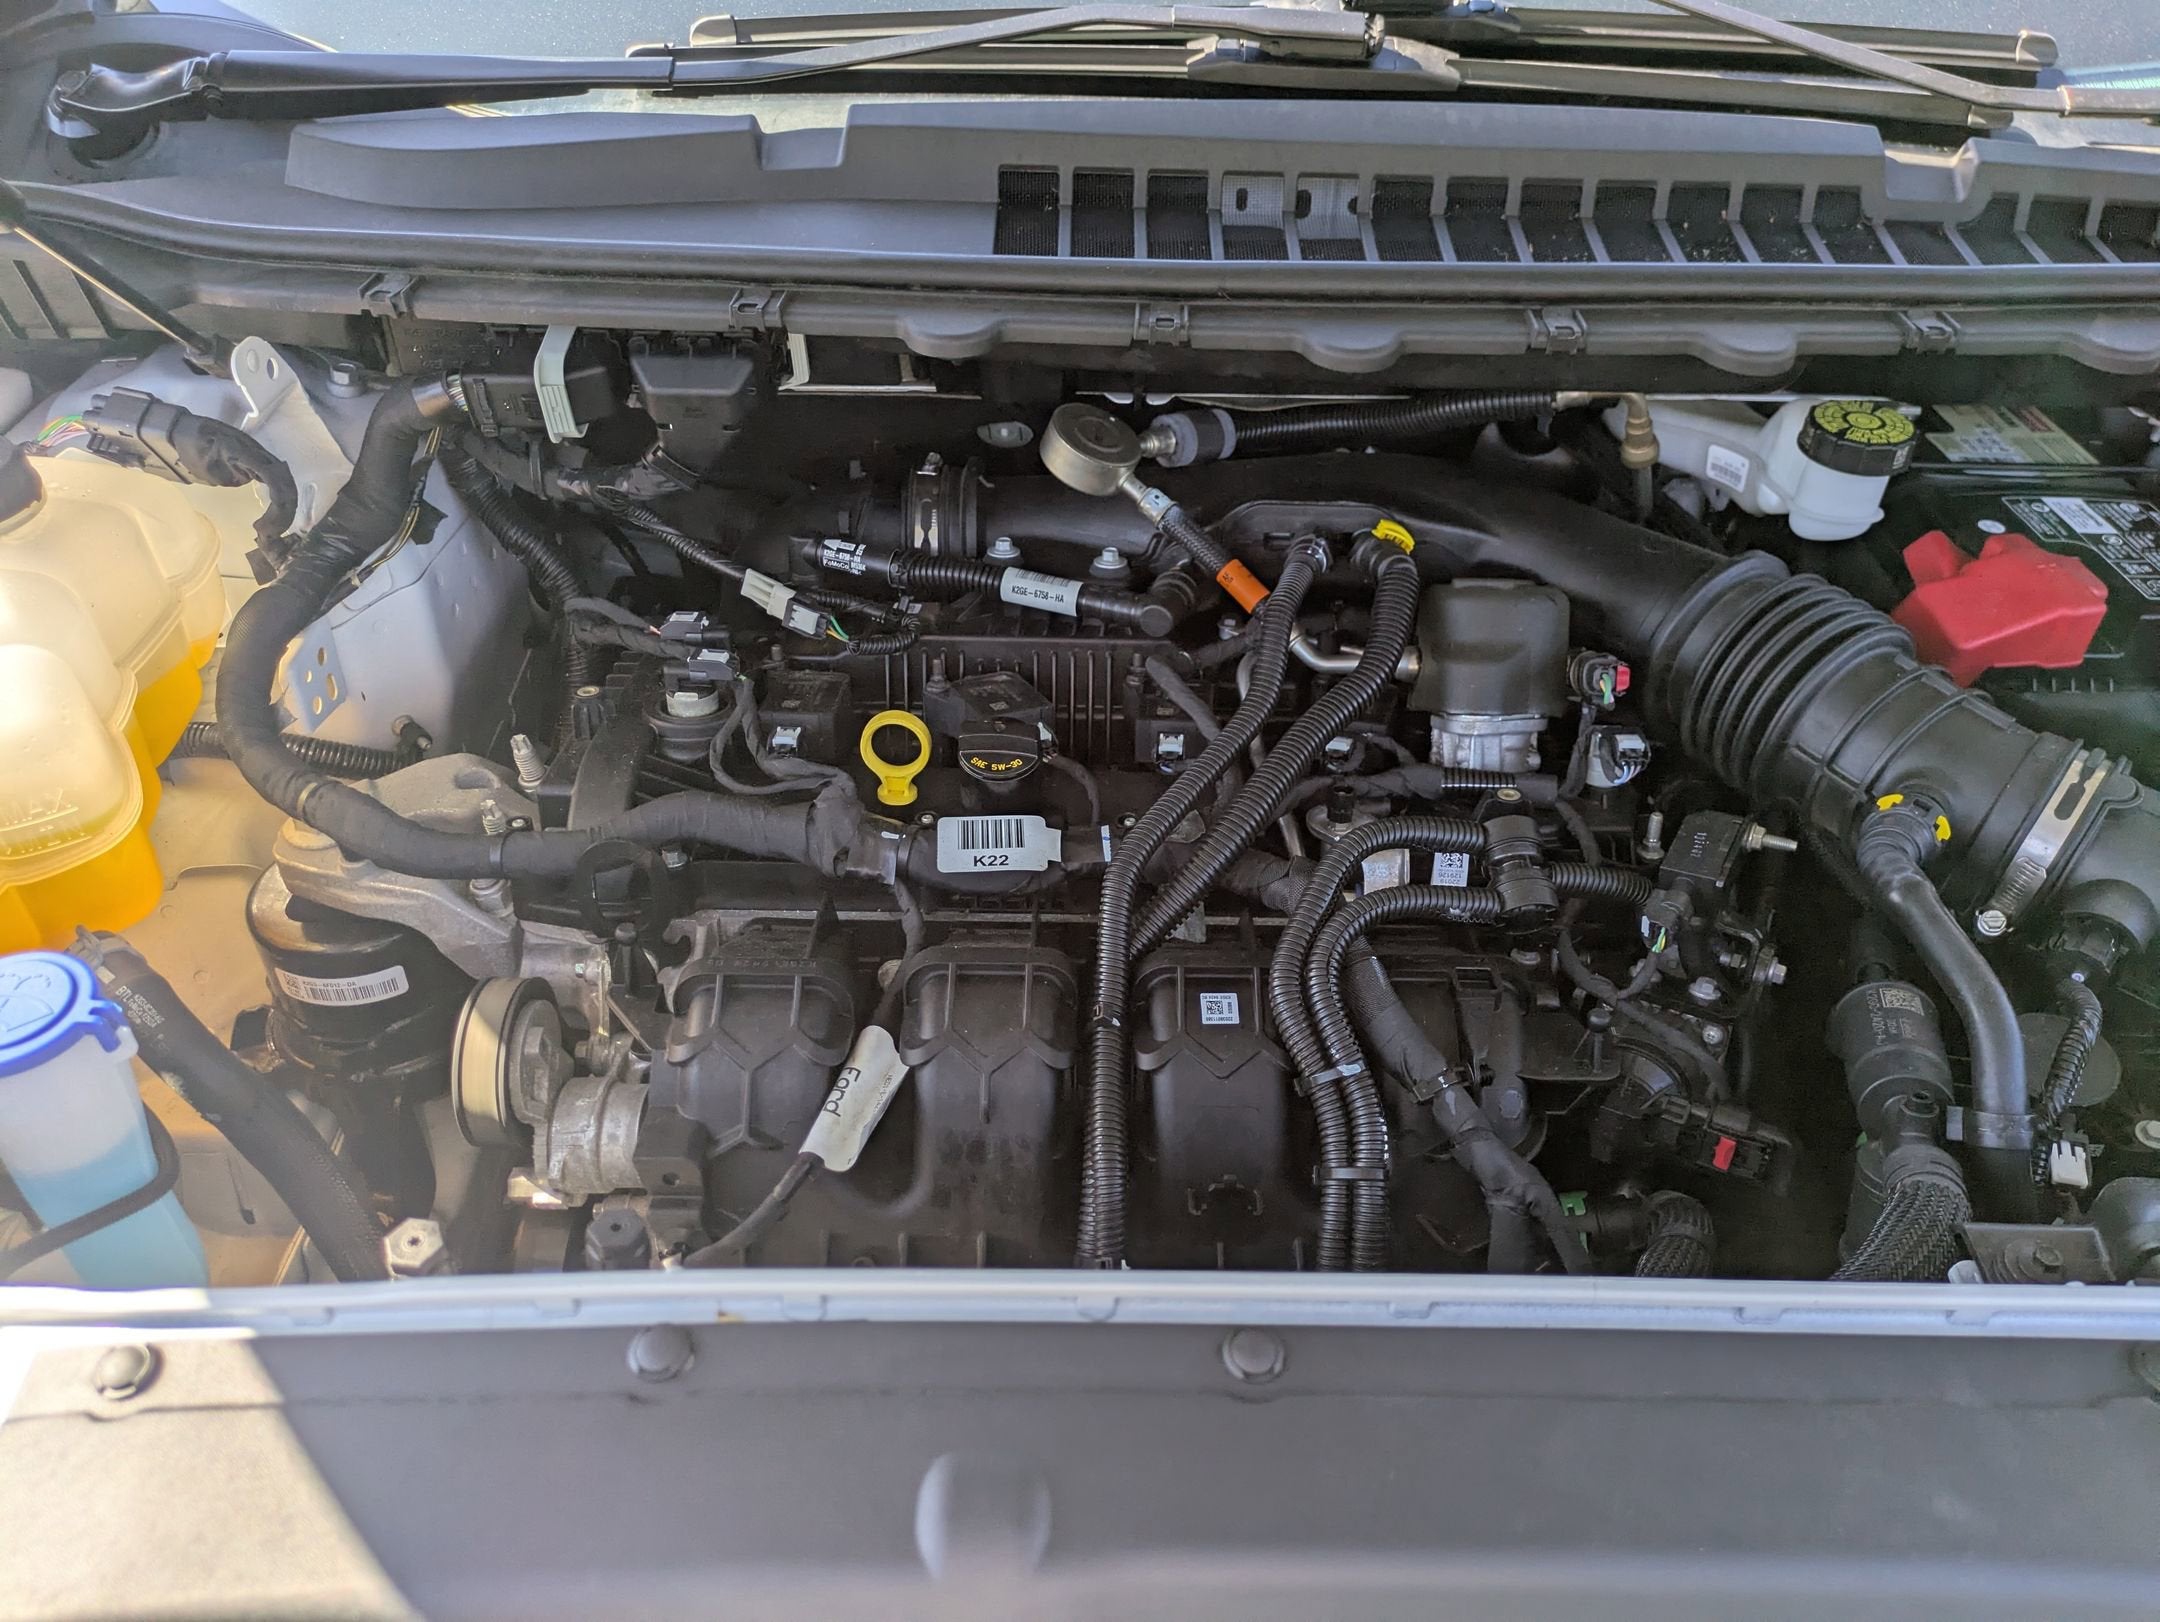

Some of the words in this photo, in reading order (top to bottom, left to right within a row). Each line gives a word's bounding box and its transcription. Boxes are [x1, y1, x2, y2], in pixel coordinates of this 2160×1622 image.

[1011, 585, 1064, 603] K2GE-6758-HA
[970, 756, 988, 769] SAE
[991, 758, 1023, 771] 5W-30
[973, 854, 1010, 867] K22
[115, 985, 133, 1002] BTL
[823, 1066, 861, 1117] Ford
